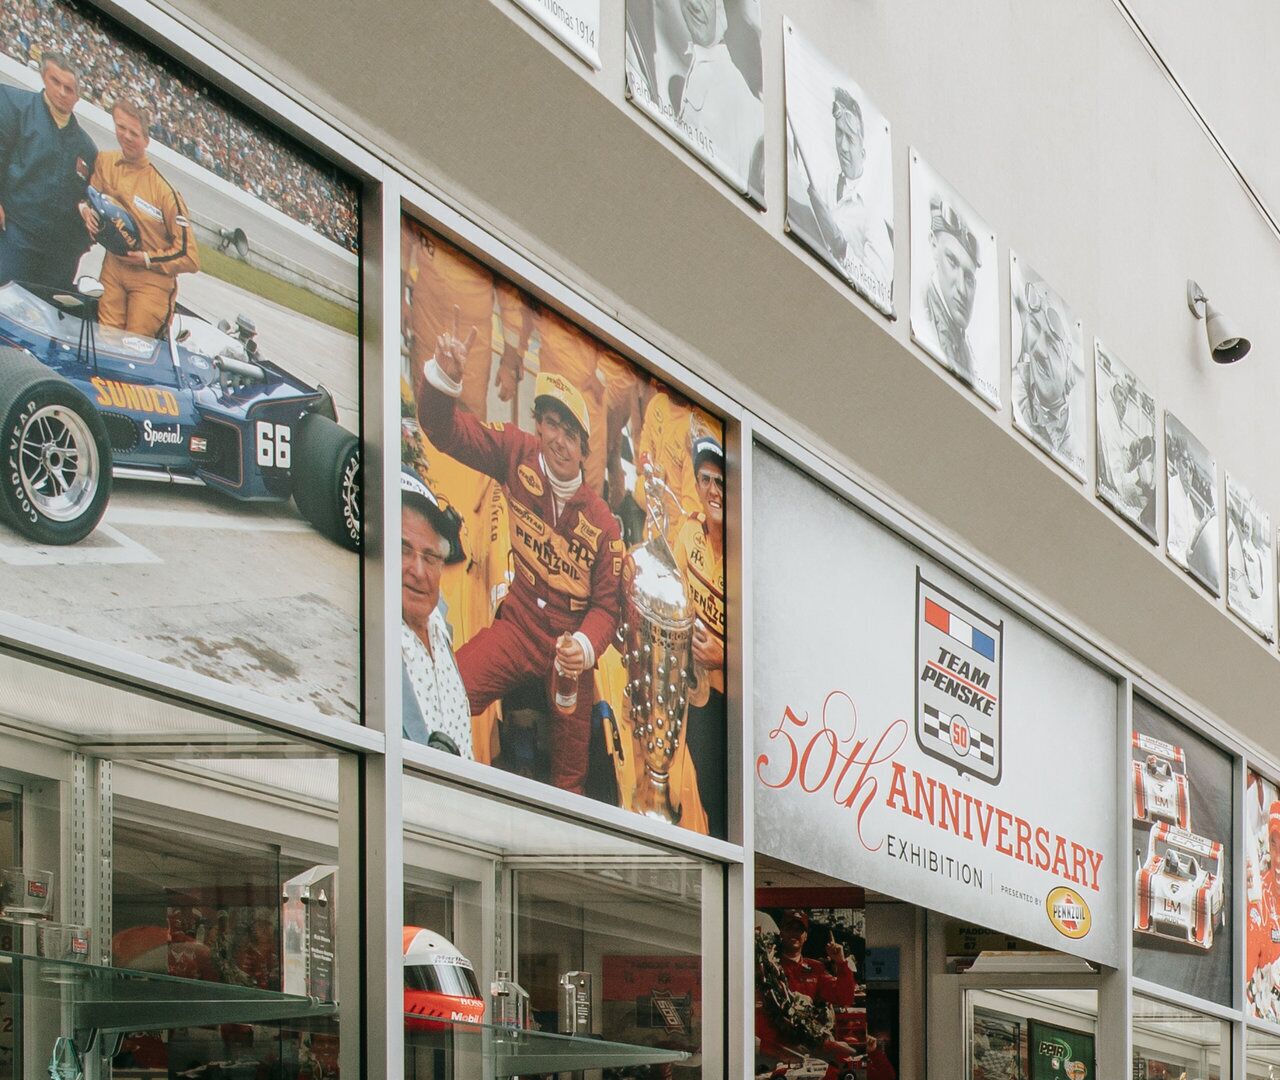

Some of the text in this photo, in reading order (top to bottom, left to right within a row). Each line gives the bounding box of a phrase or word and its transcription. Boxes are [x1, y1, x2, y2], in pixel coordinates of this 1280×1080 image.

[575, 17, 595, 48] 1914
[90, 376, 181, 418] SUNOCO
[143, 420, 184, 448] Special
[256, 421, 292, 469] 66
[938, 646, 991, 691] TEAM
[921, 664, 996, 718] PENSKE
[952, 723, 968, 750] 50
[756, 690, 1104, 892] 50th ANNIVERSARY
[887, 834, 1044, 907] EXHIBITION PRESENTED BY
[1052, 902, 1086, 922] PENNZOIL
[451, 1011, 479, 1024] Mobil
[460, 998, 483, 1008] BOSS
